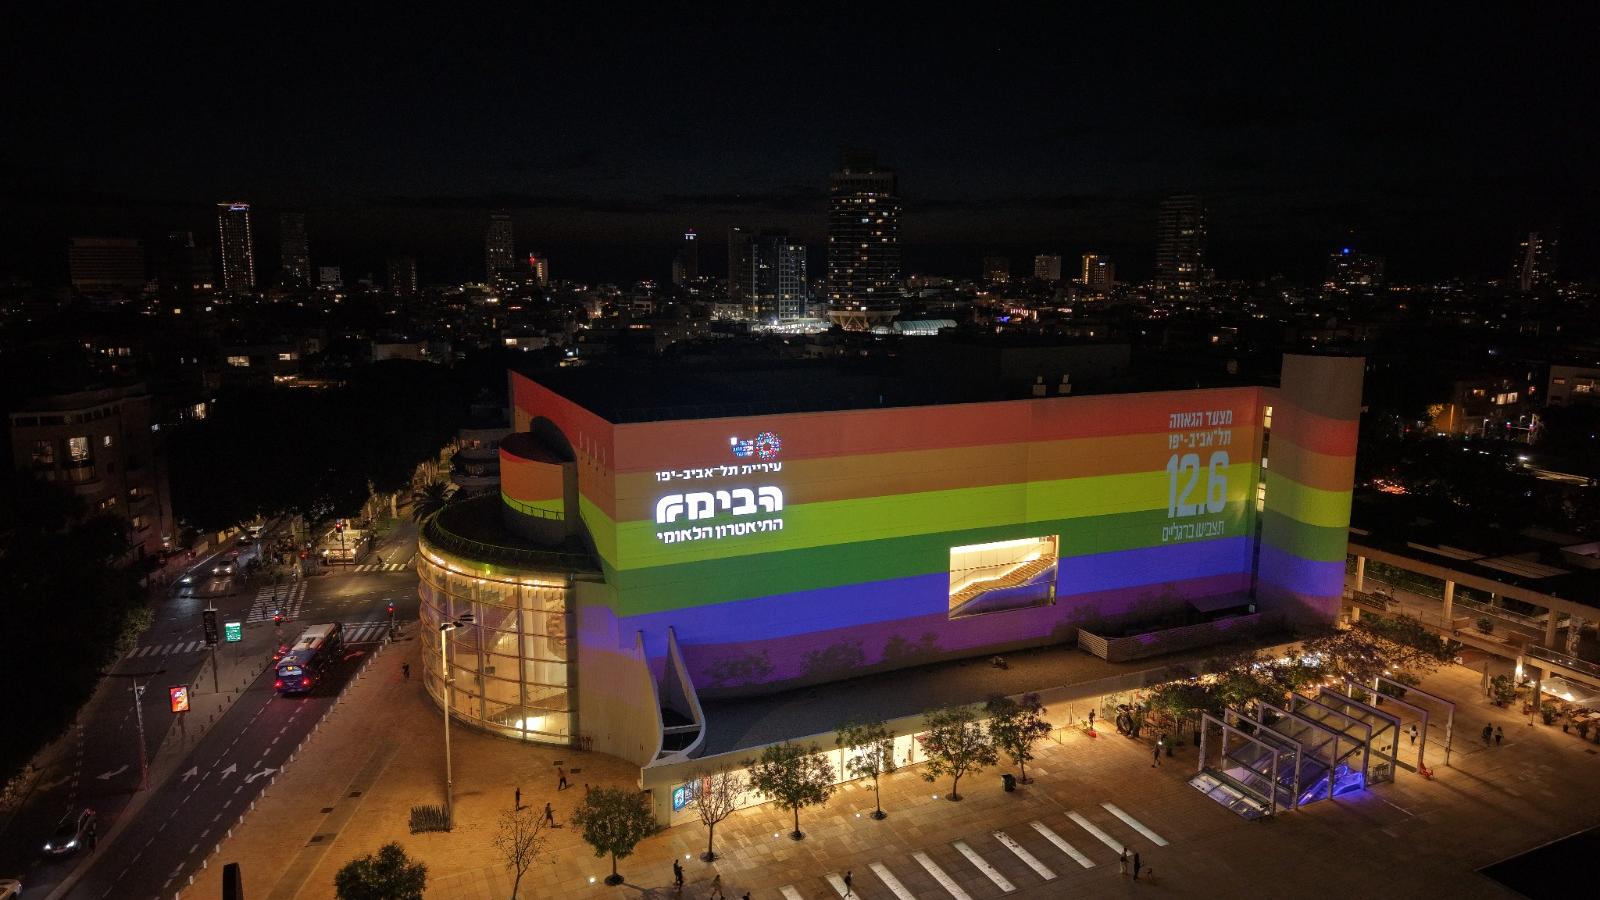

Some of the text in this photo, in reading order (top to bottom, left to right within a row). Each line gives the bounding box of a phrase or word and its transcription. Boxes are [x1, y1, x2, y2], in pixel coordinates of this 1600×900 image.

[1169, 410, 1233, 429] מצעד הגאווה
[741, 462, 782, 475] עיריית
[1167, 451, 1230, 518] 12.6
[656, 518, 784, 544] התיאטרון הלאומי
